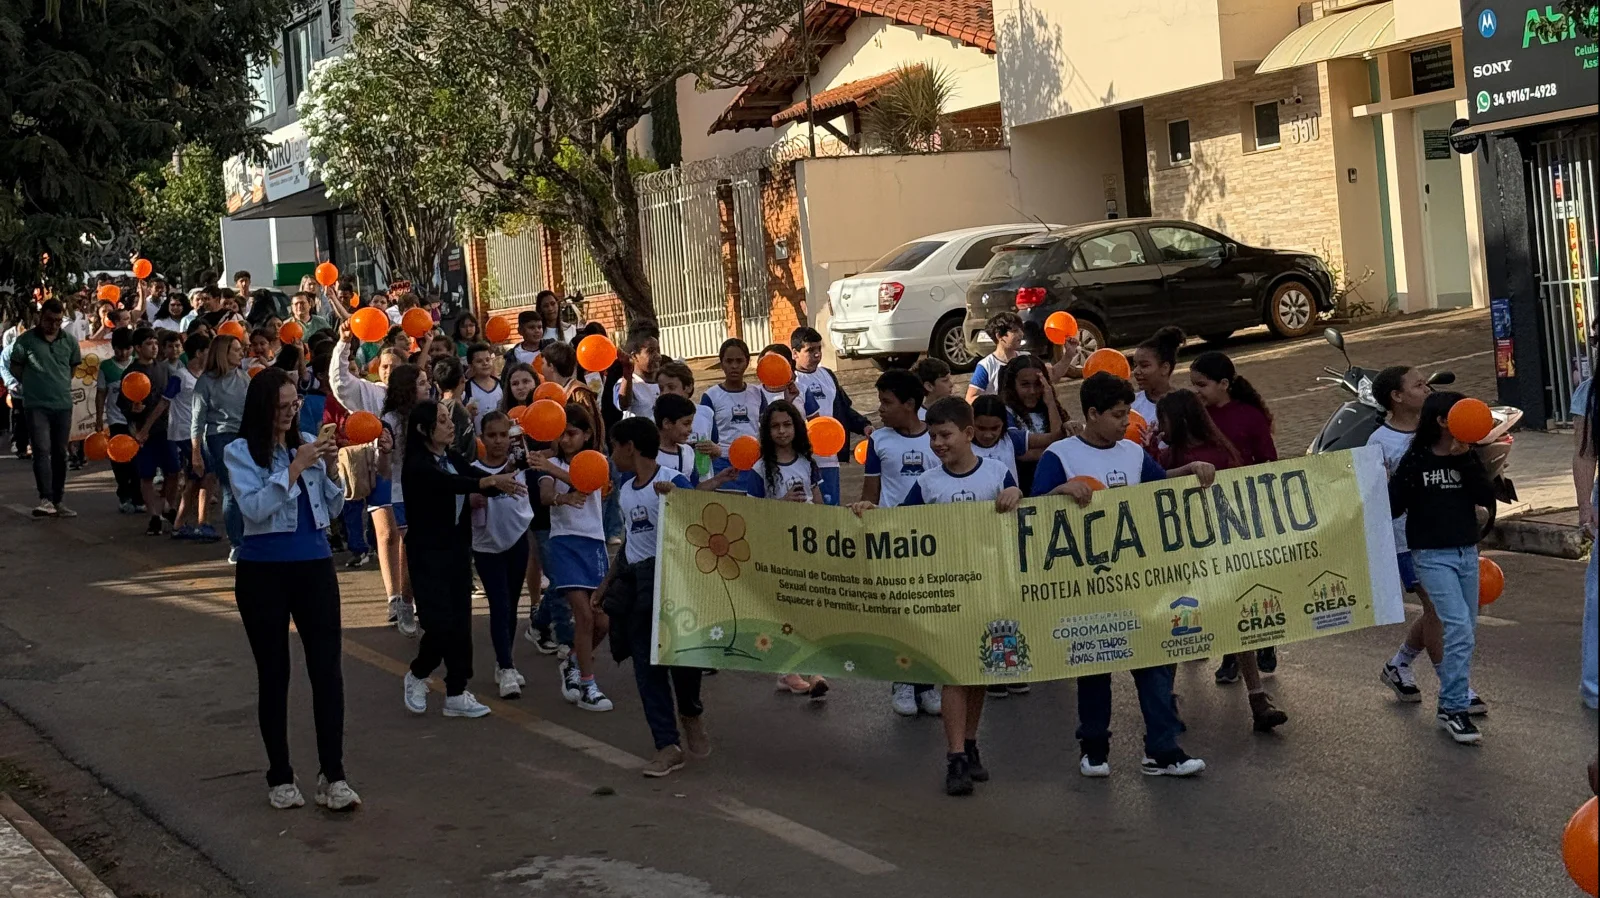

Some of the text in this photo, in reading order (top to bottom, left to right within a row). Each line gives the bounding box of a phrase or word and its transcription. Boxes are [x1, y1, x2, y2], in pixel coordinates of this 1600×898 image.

[1473, 60, 1512, 78] SONY
[1493, 83, 1557, 106] 34 99167-4928
[1291, 112, 1320, 145] 550
[1017, 469, 1318, 575] FAÇA BONITO
[788, 525, 937, 560] 18 de Maio
[755, 561, 768, 573] Dia
[770, 564, 807, 579] Nacional
[809, 570, 819, 580] de
[821, 571, 860, 584] Combate
[862, 576, 873, 586] ao
[876, 575, 907, 587] Abuso
[909, 576, 916, 585] e
[927, 571, 983, 586] Exploração
[1021, 540, 1322, 602] PROTEJA NOSSAS CRIANÇAS E ADOLESCENTES.
[779, 579, 956, 601] Sexual contra Crianças e Adolescentes
[776, 592, 814, 606] Esquecer
[863, 603, 902, 615] Lembrar
[904, 605, 911, 615] e
[913, 603, 962, 615] Combater
[1303, 594, 1357, 615] CREAS
[1052, 619, 1142, 640] COROMANDEL
[1237, 612, 1286, 632] CRAS
[1160, 632, 1215, 650] CONSELHO
[1166, 644, 1211, 658] TUTELAR
[1096, 648, 1134, 662] ATITUDES
